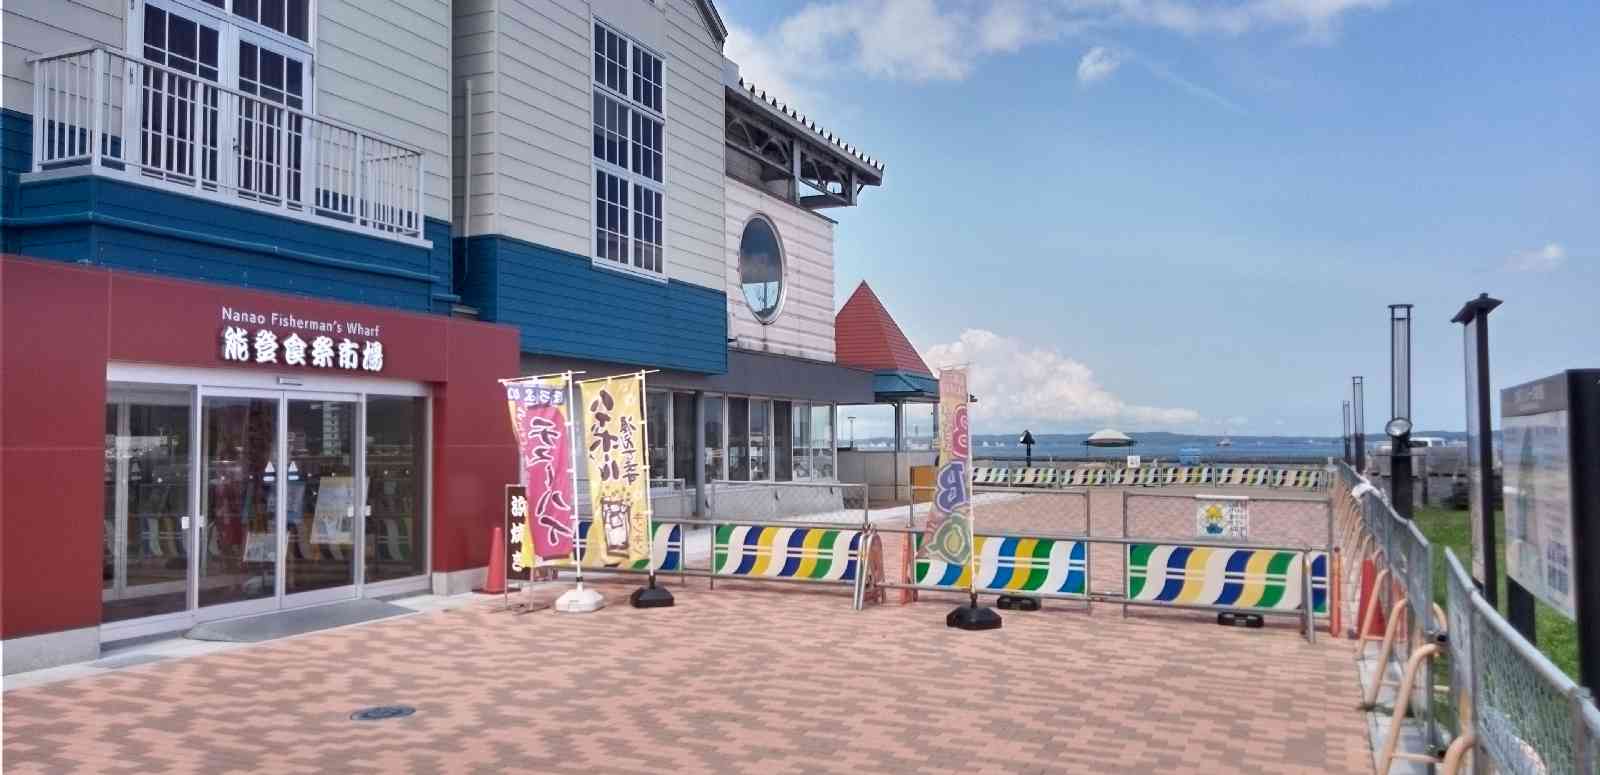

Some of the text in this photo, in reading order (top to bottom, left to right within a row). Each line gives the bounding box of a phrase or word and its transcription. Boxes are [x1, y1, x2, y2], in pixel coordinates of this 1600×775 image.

[221, 307, 380, 337] Nanao Fisherman's Wharf
[223, 326, 384, 371] 能登食祭市場
